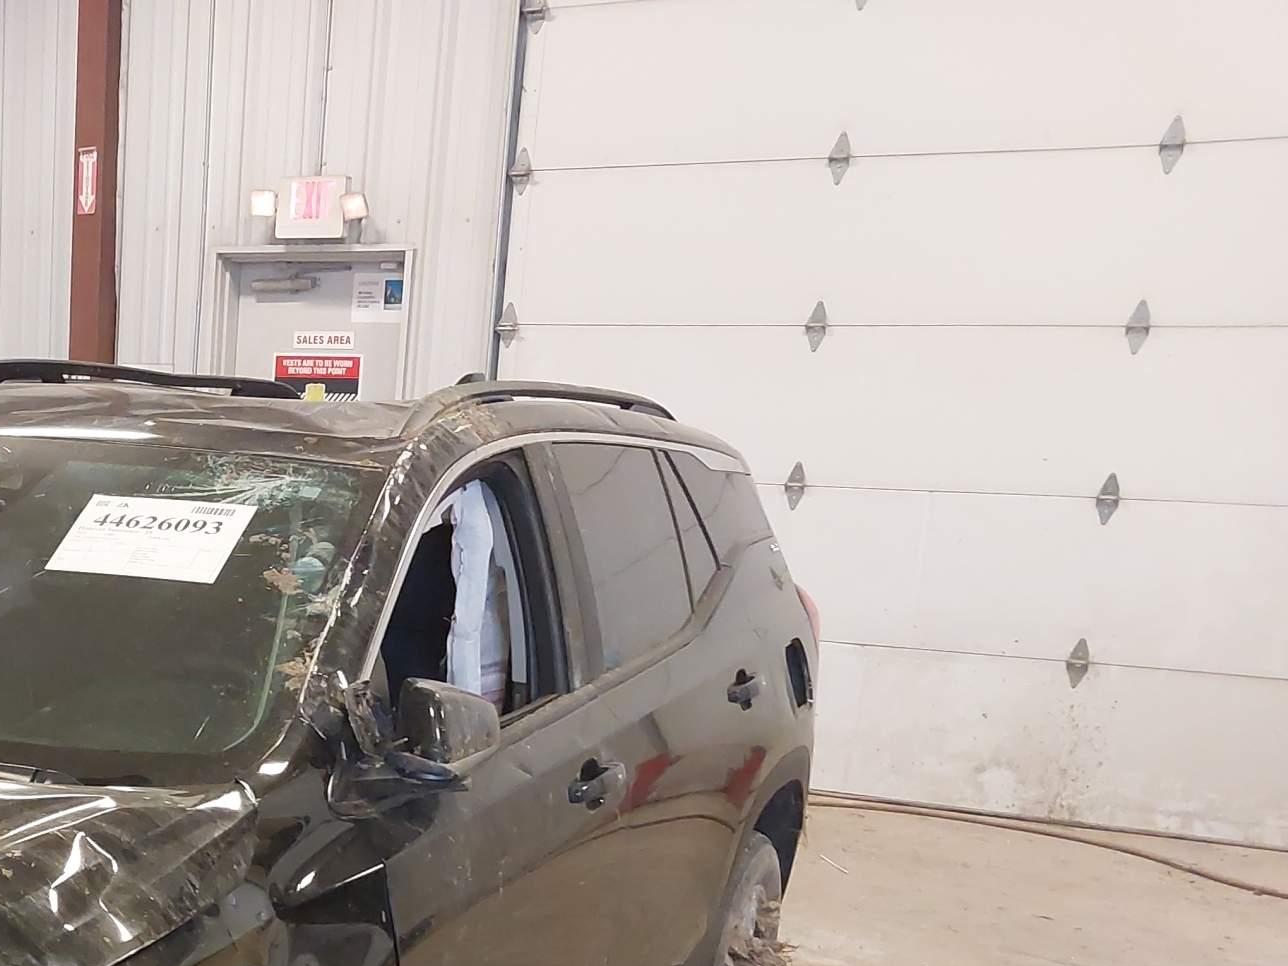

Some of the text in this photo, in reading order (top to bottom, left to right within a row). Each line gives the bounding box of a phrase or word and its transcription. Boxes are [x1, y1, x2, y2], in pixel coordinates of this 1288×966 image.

[296, 335, 351, 345] SALES AREA
[288, 367, 312, 375] BEYOND
[327, 367, 347, 375] POINT
[93, 512, 224, 535] 44626093
